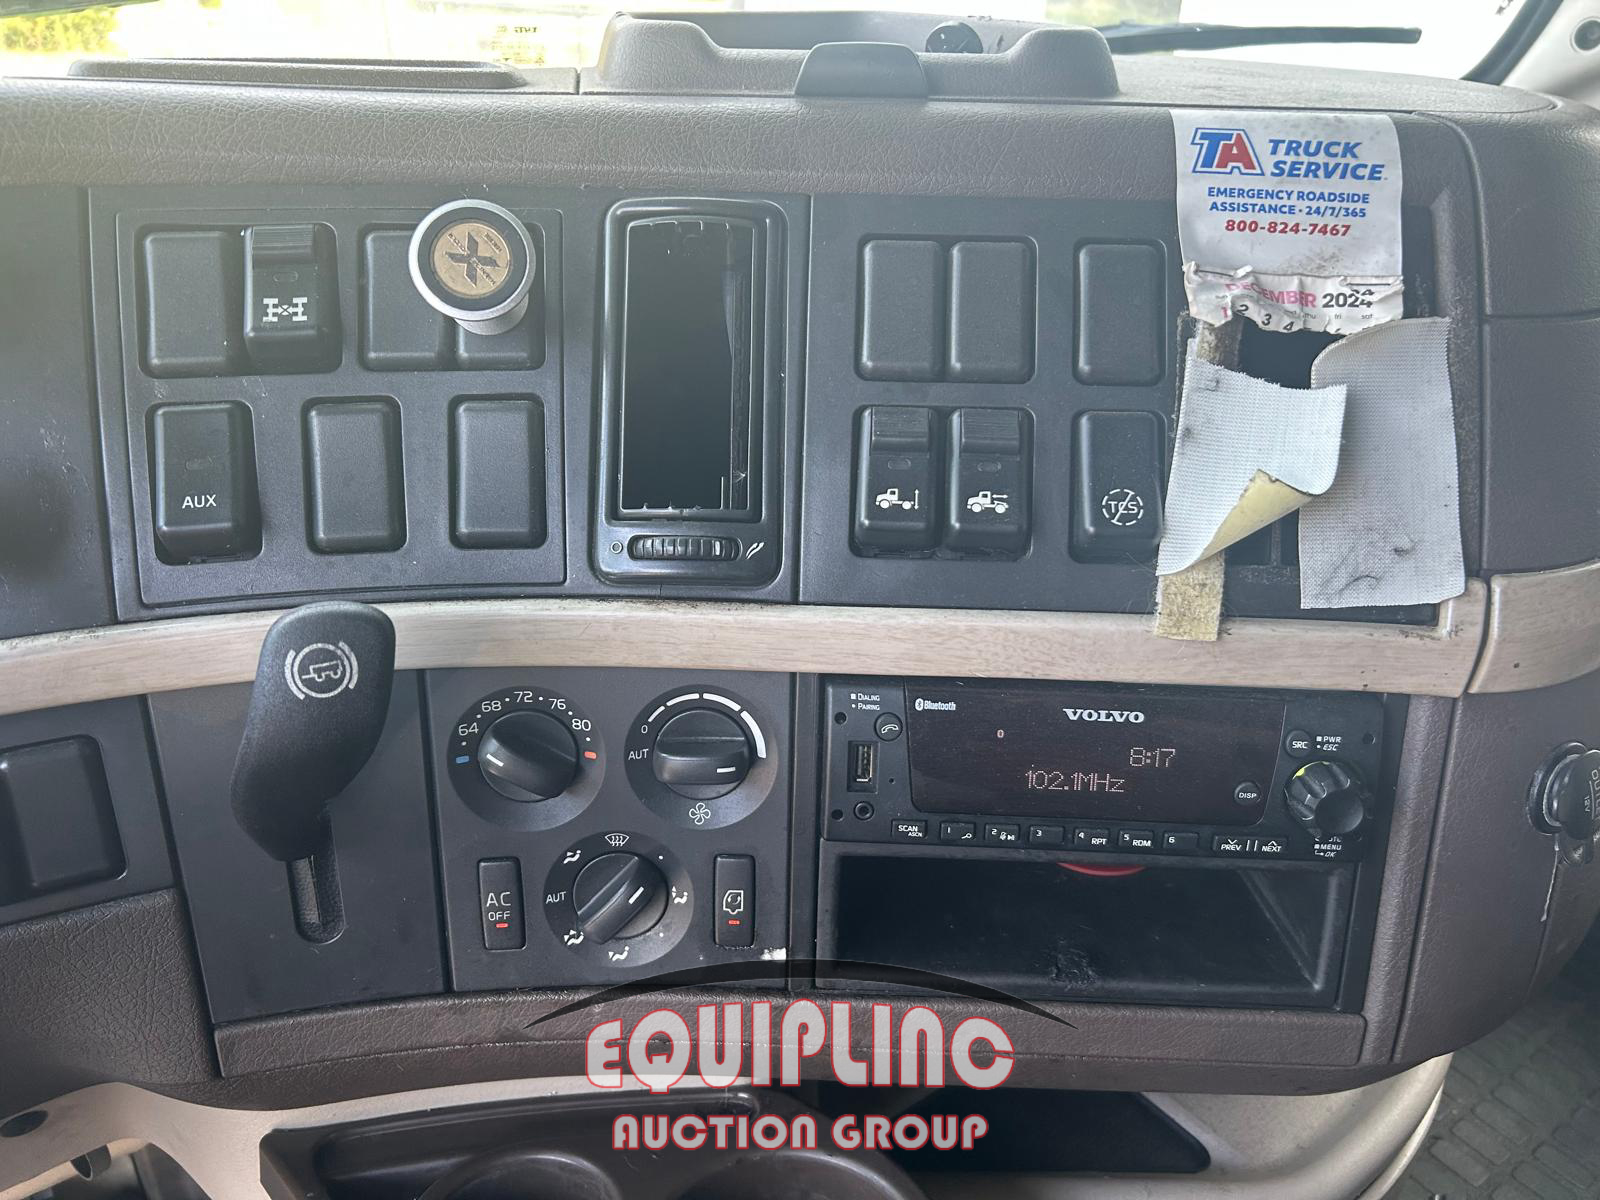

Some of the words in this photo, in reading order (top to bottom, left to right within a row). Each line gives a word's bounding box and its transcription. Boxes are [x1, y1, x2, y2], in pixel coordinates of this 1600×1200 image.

[1196, 130, 1260, 173] TA
[1268, 139, 1362, 158] TRUCK
[1271, 161, 1385, 181] SERVICE
[1207, 187, 1294, 200] EMERGENCY
[1297, 191, 1370, 204] ROADSIDE
[1209, 202, 1296, 215] ASSISTANCE
[1305, 206, 1367, 218] 24/7/365
[1224, 220, 1352, 237] 800-824-7467
[1221, 306, 1229, 319] 1
[1236, 304, 1249, 316] 2
[1261, 313, 1272, 326] 3
[1283, 320, 1295, 332] 4
[182, 494, 217, 509] AUX
[924, 700, 957, 711] Bluetooth
[458, 722, 479, 737] 64
[481, 699, 502, 713] 68
[513, 691, 533, 704] 72
[547, 698, 567, 711] 76
[571, 717, 592, 732] 80
[1063, 708, 1145, 723] VOLVO
[1292, 740, 1309, 750] SRC
[1323, 735, 1342, 744] PWR
[1322, 743, 1338, 752] ESC
[628, 748, 649, 761] AUT
[1130, 747, 1176, 768] 8:17
[1025, 770, 1125, 793] 102.1MHz
[1238, 791, 1257, 800] DISP
[898, 824, 919, 833] SCAN
[991, 828, 998, 836] 2
[1036, 829, 1042, 837] 3
[1078, 831, 1085, 839] 4
[1168, 836, 1175, 844] 6
[1091, 837, 1108, 846] RPT
[1132, 839, 1152, 848] RDM
[1221, 843, 1243, 852] PREV
[1261, 844, 1282, 853] NEXT
[545, 891, 567, 904] AUT
[488, 910, 511, 921] OFF
